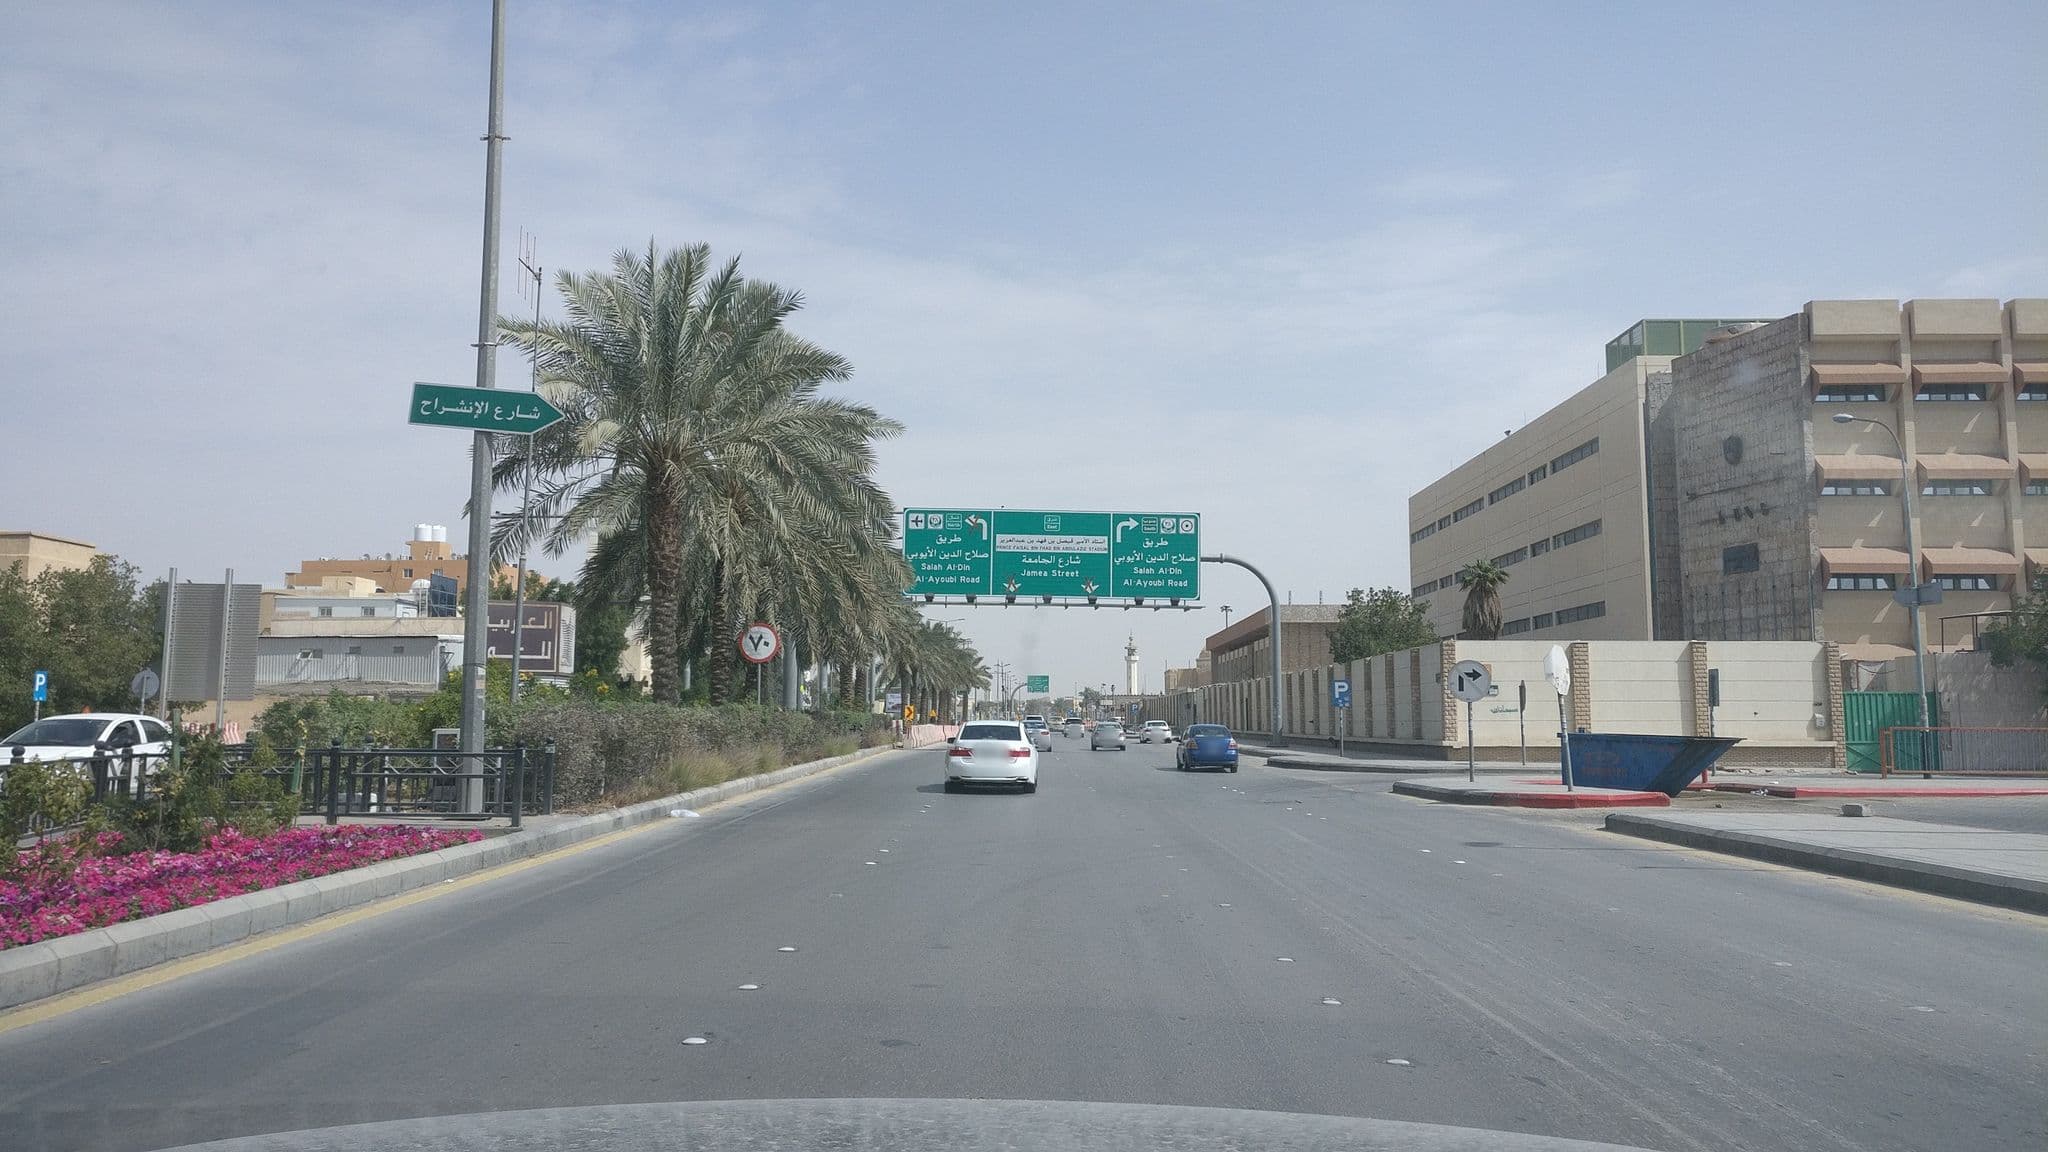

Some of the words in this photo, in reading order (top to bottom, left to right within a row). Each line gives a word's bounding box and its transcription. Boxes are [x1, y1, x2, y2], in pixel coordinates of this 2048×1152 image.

[420, 397, 489, 419] الإنشراح
[493, 405, 540, 420] شارع
[935, 533, 962, 545] طريق
[1142, 537, 1169, 549] طريق
[939, 549, 962, 560] الدين
[965, 549, 989, 561] صلاح
[1021, 554, 1056, 565] الجامعة
[1114, 550, 1144, 565] الأيوبي
[1145, 553, 1169, 563] الدين
[1171, 553, 1196, 564] صلاح
[921, 563, 943, 571] Salah
[1057, 555, 1082, 568] شارع
[1021, 569, 1048, 577] Jamea
[1051, 569, 1080, 577] Street
[960, 576, 981, 584] Road
[1123, 579, 1165, 588] Al-Ayoubi
[35, 673, 46, 691] P
[1335, 681, 1349, 699] P
